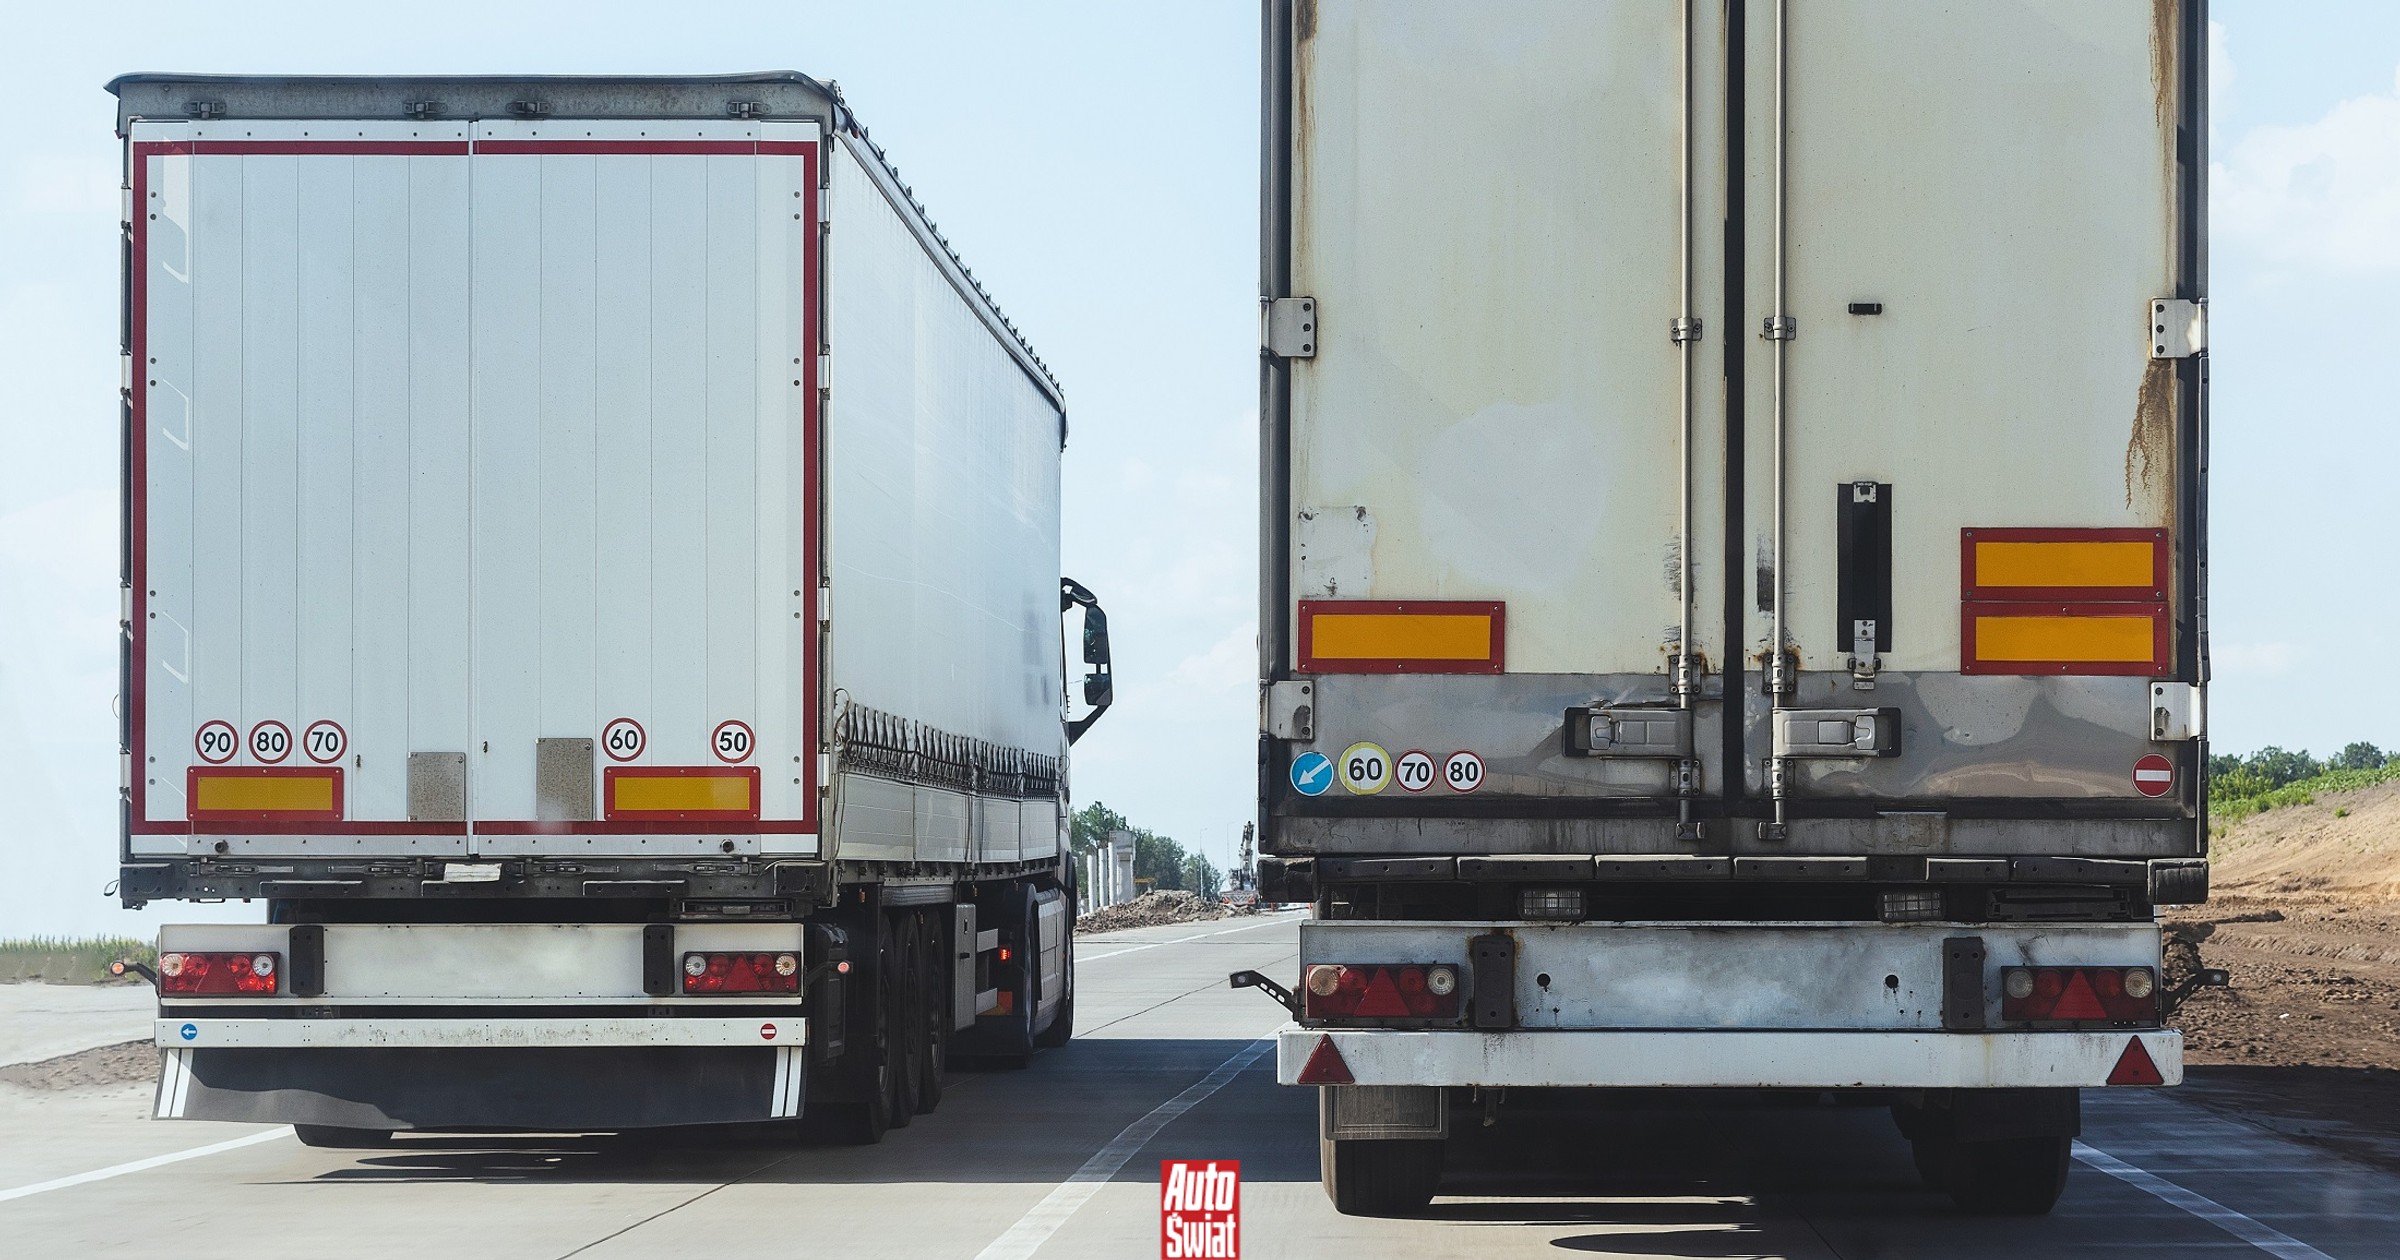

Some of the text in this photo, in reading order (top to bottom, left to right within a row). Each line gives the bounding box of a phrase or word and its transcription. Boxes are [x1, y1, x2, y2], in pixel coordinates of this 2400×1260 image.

[202, 731, 231, 753] 90
[256, 731, 285, 752] 80
[311, 731, 339, 752] 70
[609, 728, 639, 751] 60
[719, 731, 747, 752] 50
[1349, 757, 1383, 782] 60
[1401, 761, 1430, 783] 70
[1449, 761, 1479, 783] 80
